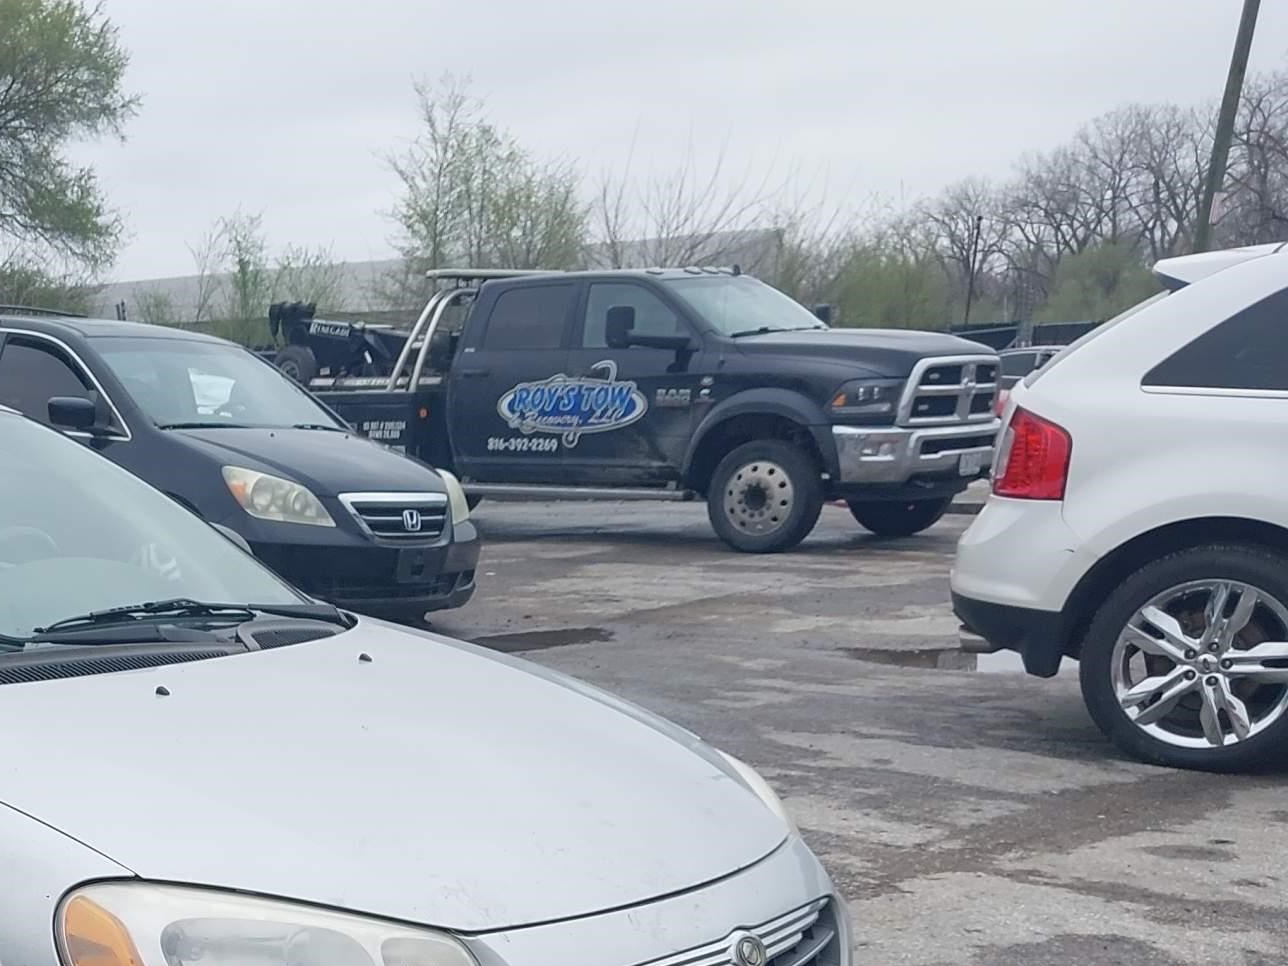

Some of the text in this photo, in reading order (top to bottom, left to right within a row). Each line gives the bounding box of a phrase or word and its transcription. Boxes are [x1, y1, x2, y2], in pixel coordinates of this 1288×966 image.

[514, 383, 633, 412] ROY'S TOW
[587, 409, 624, 424] LLC
